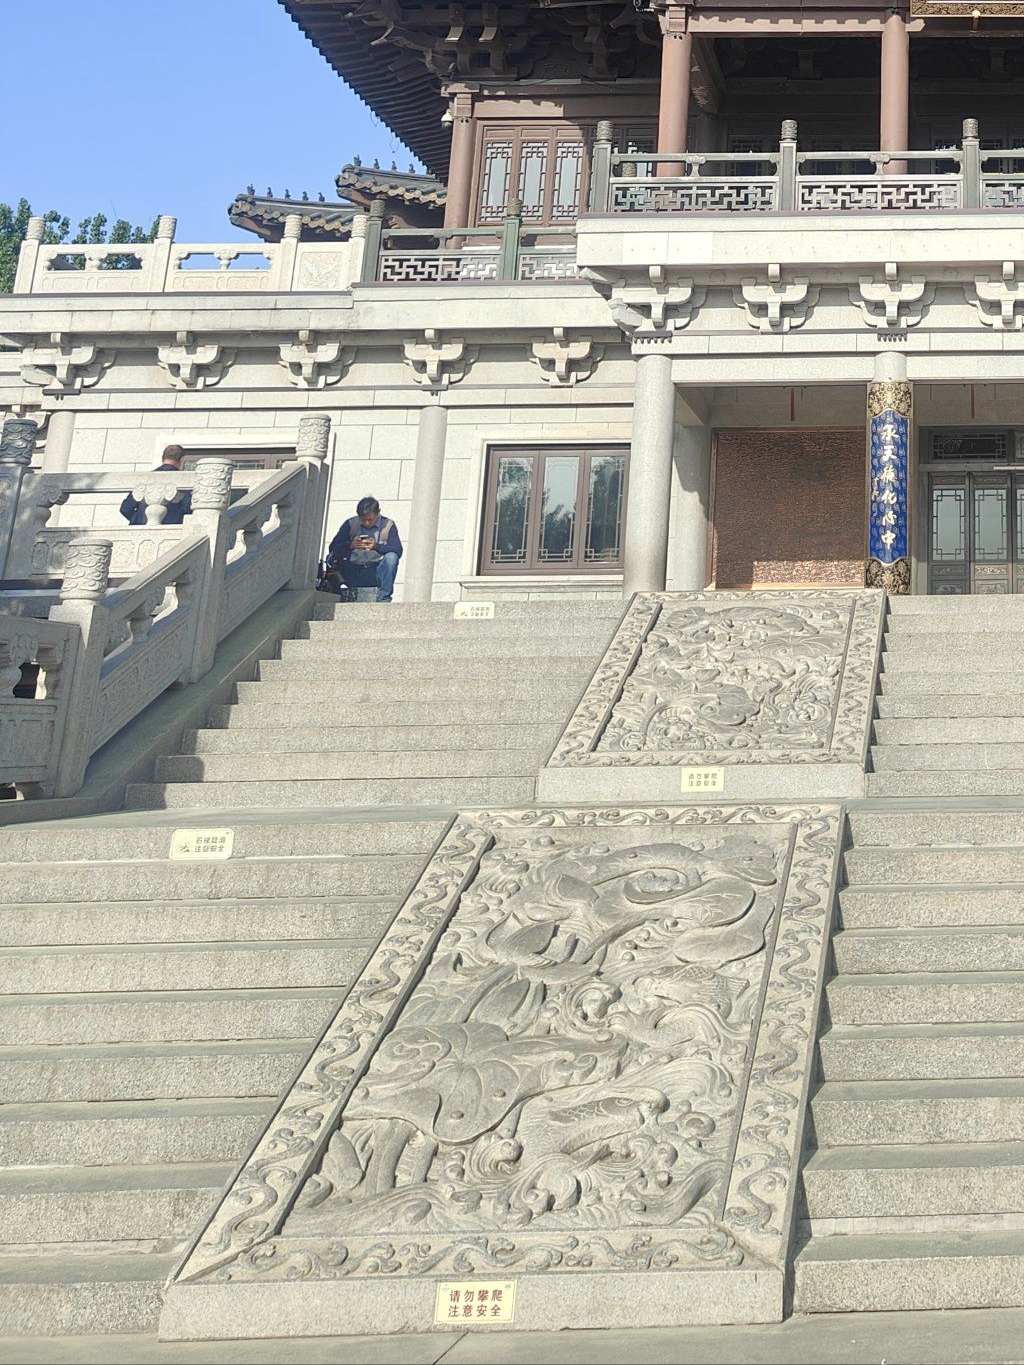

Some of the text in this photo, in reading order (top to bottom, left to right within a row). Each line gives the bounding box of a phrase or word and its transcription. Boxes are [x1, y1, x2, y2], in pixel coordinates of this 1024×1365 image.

[449, 1289, 503, 1303] 请勿攀爬
[448, 1304, 502, 1318] 注意安全
